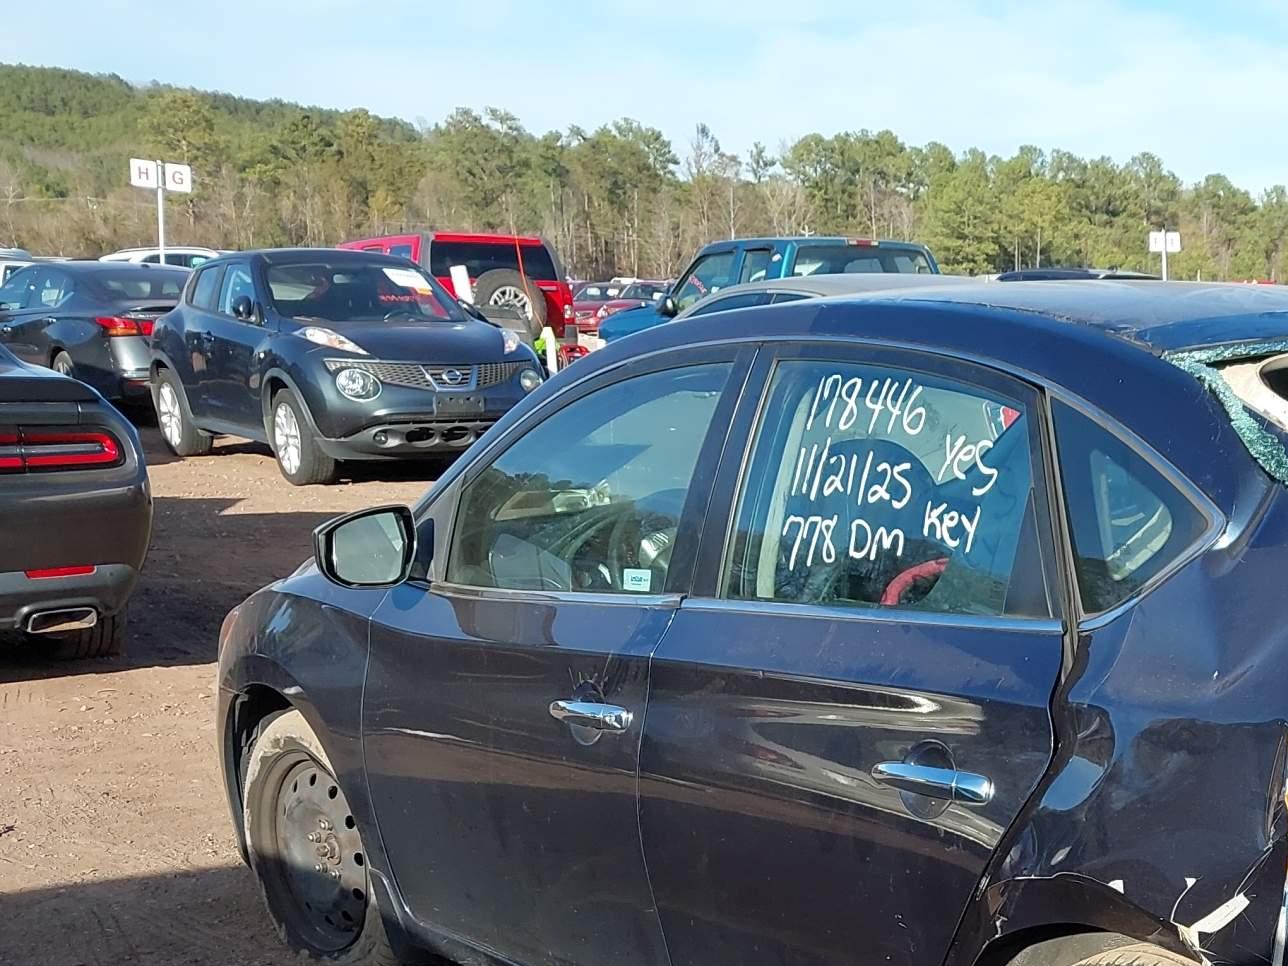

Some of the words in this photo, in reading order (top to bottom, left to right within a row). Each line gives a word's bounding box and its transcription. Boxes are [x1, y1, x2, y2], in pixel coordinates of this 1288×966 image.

[138, 166, 149, 181] H
[172, 170, 184, 185] G
[806, 374, 926, 434] 178446
[791, 437, 912, 509] 11/21/25
[782, 514, 839, 571] 778
[849, 518, 904, 561] DM
